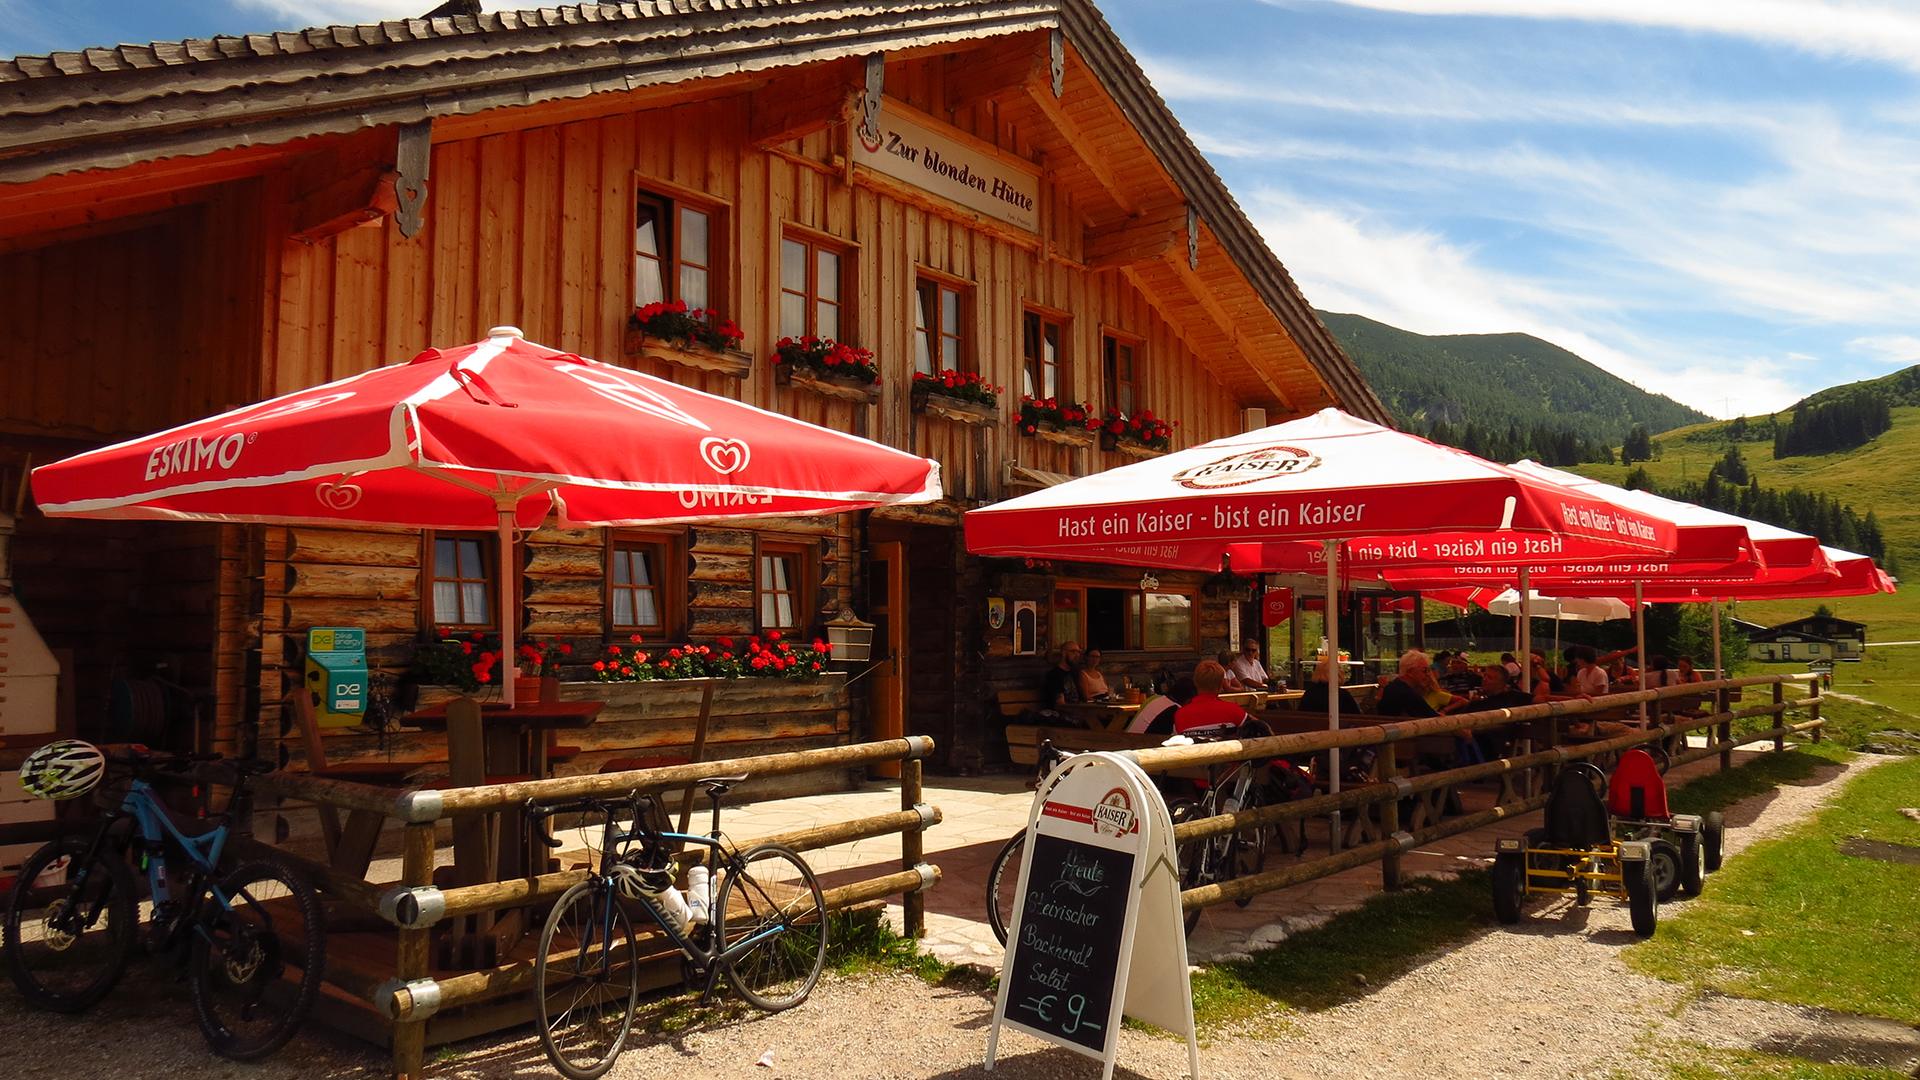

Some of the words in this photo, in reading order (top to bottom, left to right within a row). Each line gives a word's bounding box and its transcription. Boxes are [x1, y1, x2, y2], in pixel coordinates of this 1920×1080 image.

[885, 131, 919, 163] Zur
[924, 147, 986, 193] blonden
[990, 176, 1033, 212] Hütte
[144, 432, 245, 481] ESKIMO
[1194, 459, 1300, 477] KAISER
[1058, 516, 1096, 537] Hast
[1102, 513, 1129, 535] ein
[1137, 509, 1193, 534] Kaiser
[1214, 504, 1250, 529] bist
[1258, 503, 1289, 527] ein
[1299, 500, 1366, 525] Kaiser
[1560, 502, 1579, 526] Hast
[1579, 506, 1593, 529] ein
[1590, 509, 1613, 532] Kaiser
[1613, 512, 1630, 536] bist
[1628, 517, 1640, 538] ein
[1637, 520, 1657, 542] Kaiser
[1097, 805, 1128, 827] KAISER
[1028, 891, 1100, 926] Steirischer
[1023, 923, 1093, 968] Backhendl
[1030, 962, 1070, 991] Salat
